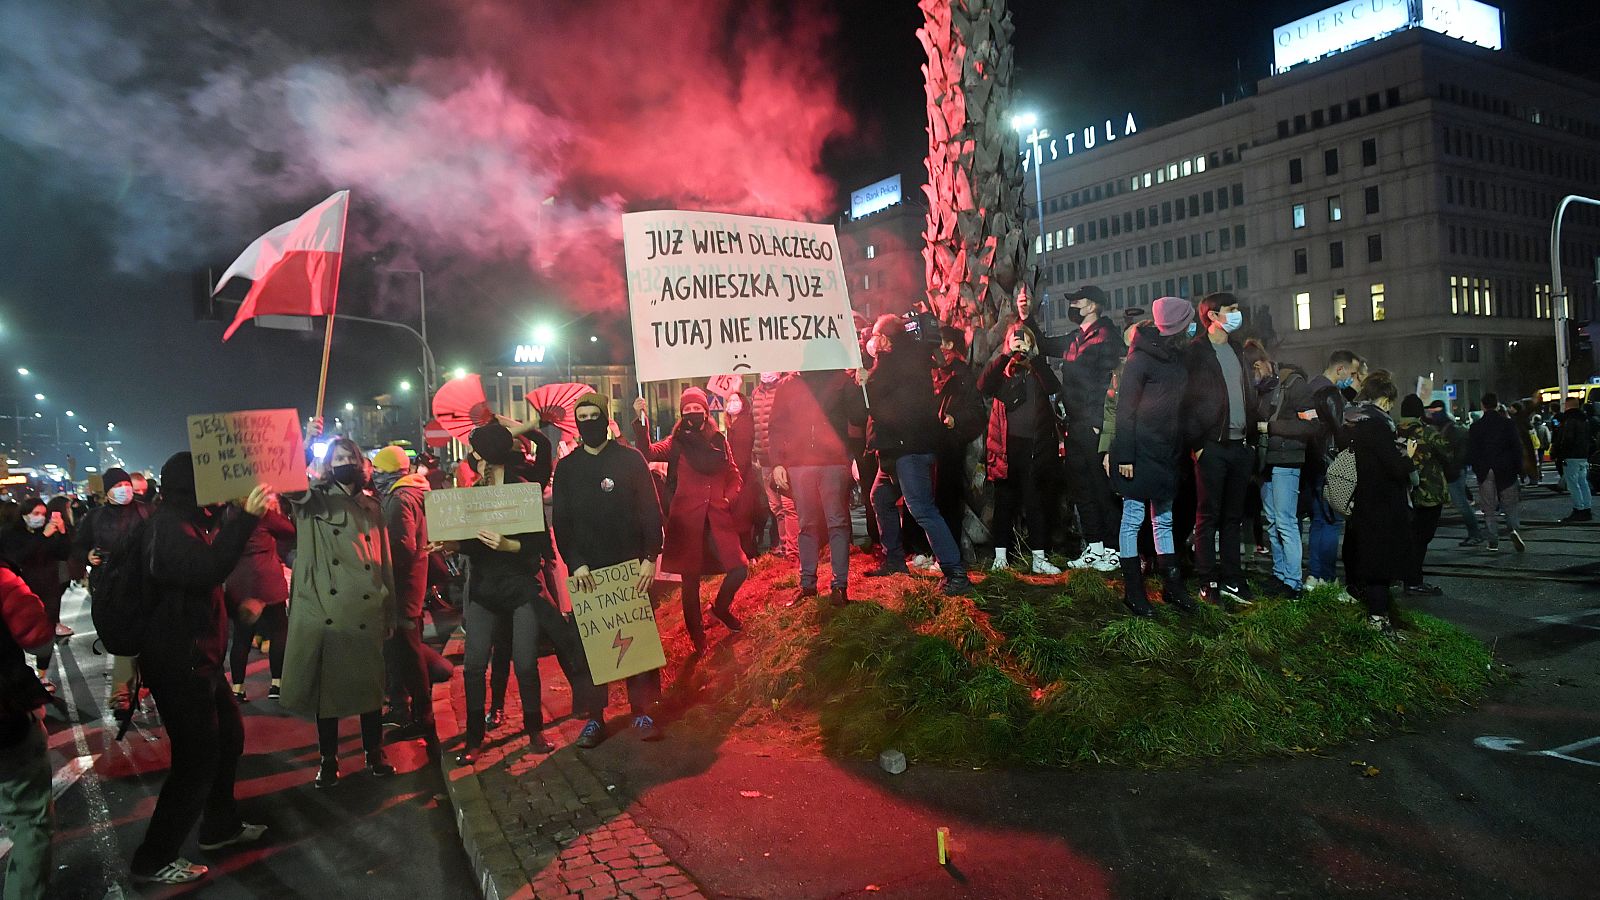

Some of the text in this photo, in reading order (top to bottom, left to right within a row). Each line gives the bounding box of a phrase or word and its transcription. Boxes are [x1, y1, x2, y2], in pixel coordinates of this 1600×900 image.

[645, 229, 833, 261] JUŻ WIEM DLACZEGO
[783, 274, 824, 302] JUŻ
[651, 319, 712, 350] TUTAJ
[720, 317, 753, 344] NIE
[594, 562, 640, 586] STOJĘ
[575, 600, 593, 616] JA
[580, 605, 653, 638] JA WALCZĘ
